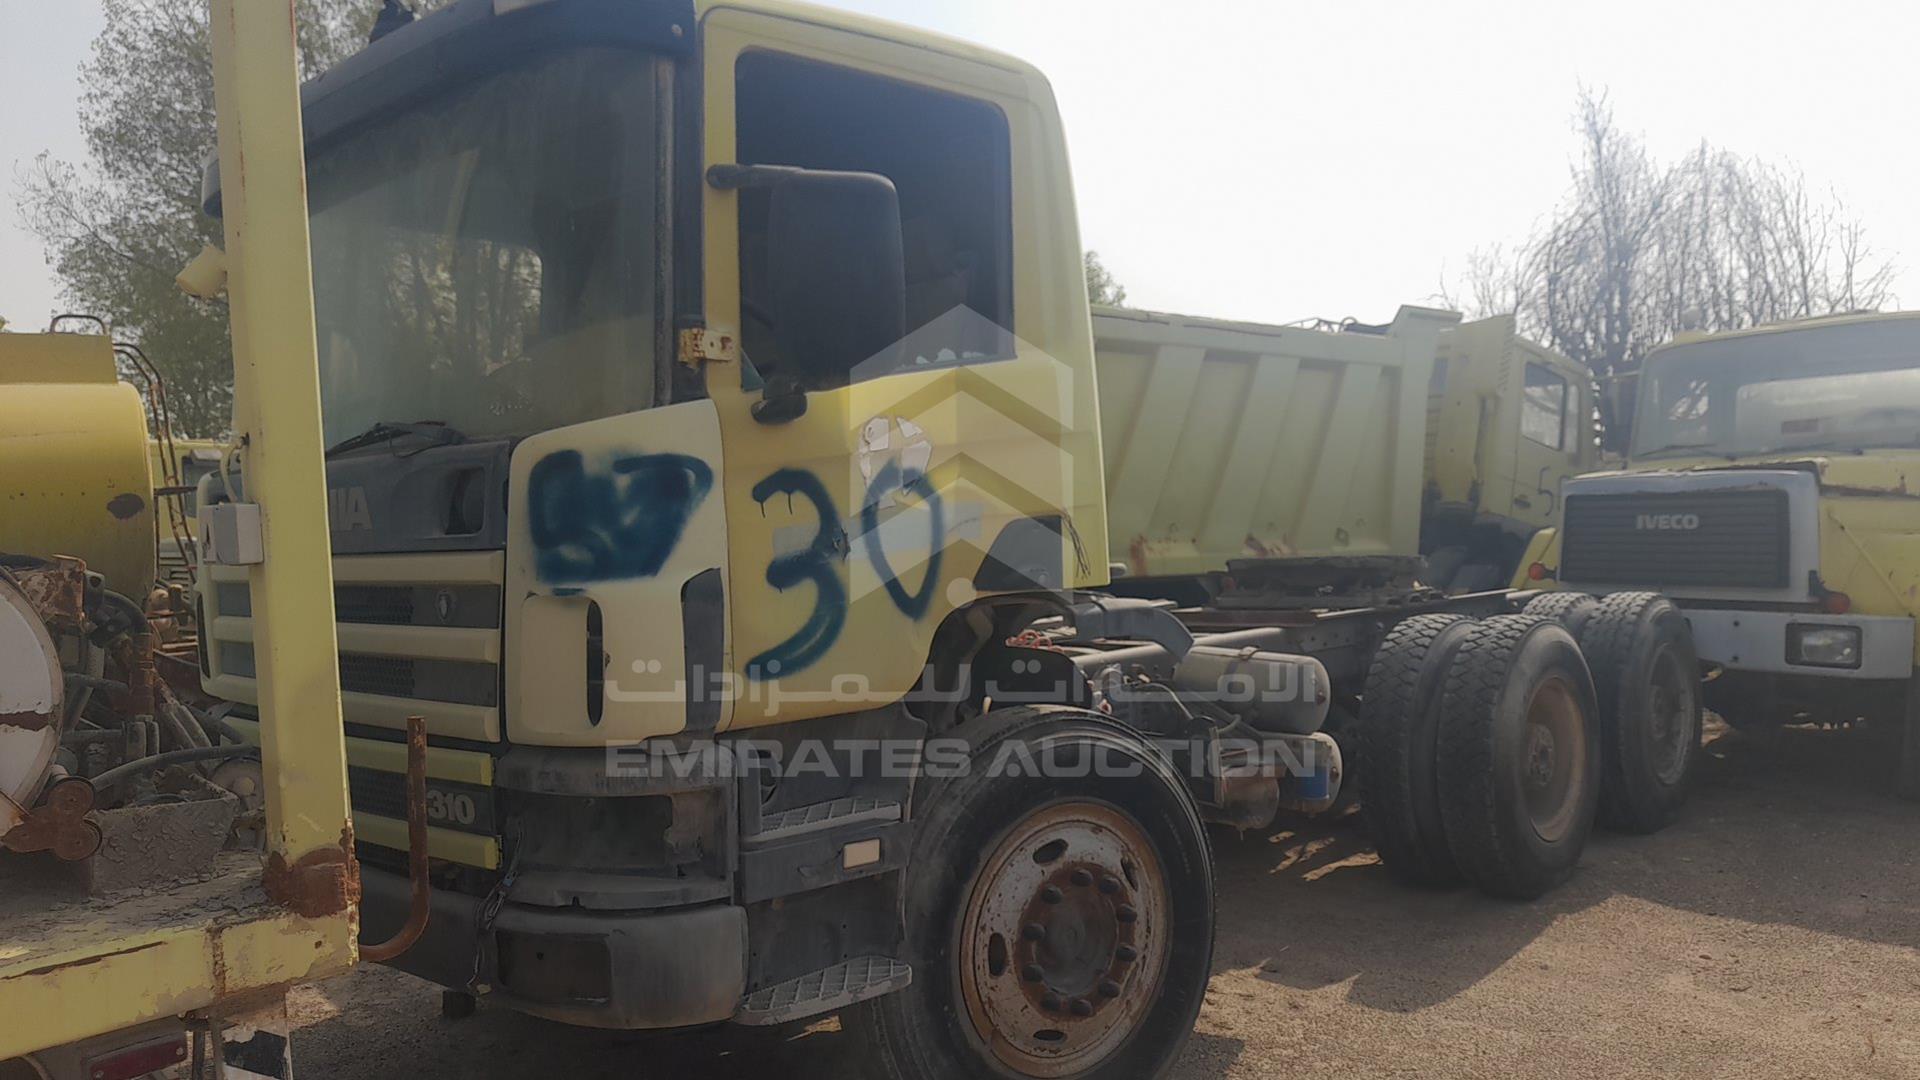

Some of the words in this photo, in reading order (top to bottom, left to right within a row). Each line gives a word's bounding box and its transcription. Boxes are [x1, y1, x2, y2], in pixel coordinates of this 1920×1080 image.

[1636, 514, 1699, 530] IVECO
[746, 457, 943, 682] 30
[427, 789, 475, 825] 310
